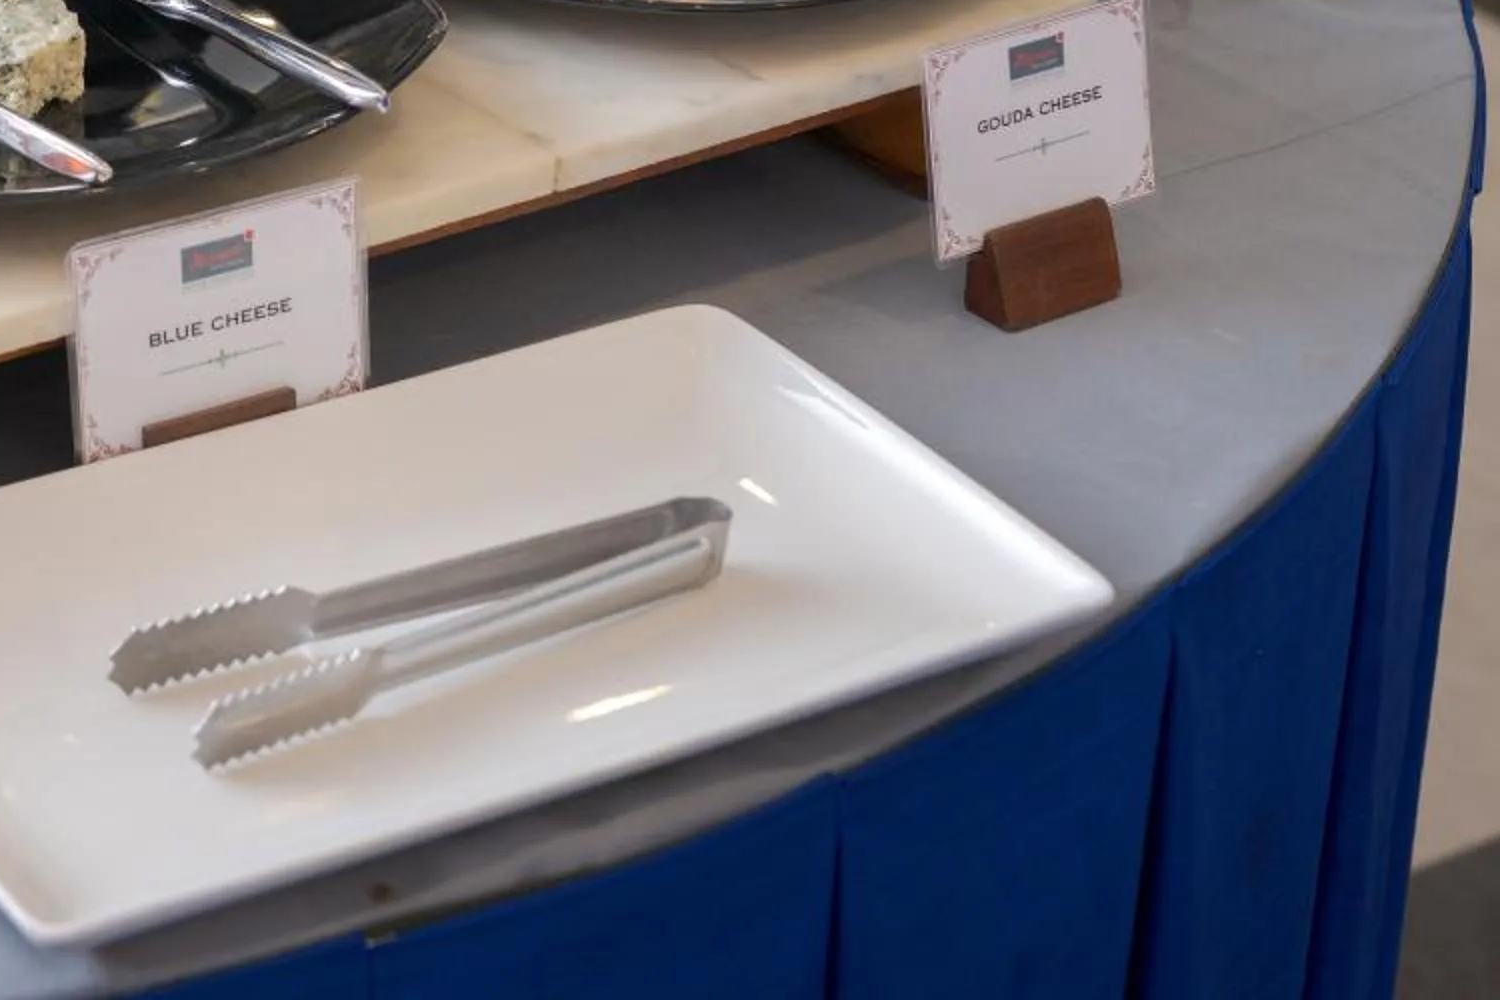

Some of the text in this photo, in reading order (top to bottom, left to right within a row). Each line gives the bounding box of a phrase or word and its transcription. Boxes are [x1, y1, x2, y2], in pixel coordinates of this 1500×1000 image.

[977, 85, 1103, 134] GOUDA CHEESE
[149, 297, 293, 348] BLUE CHEESE
